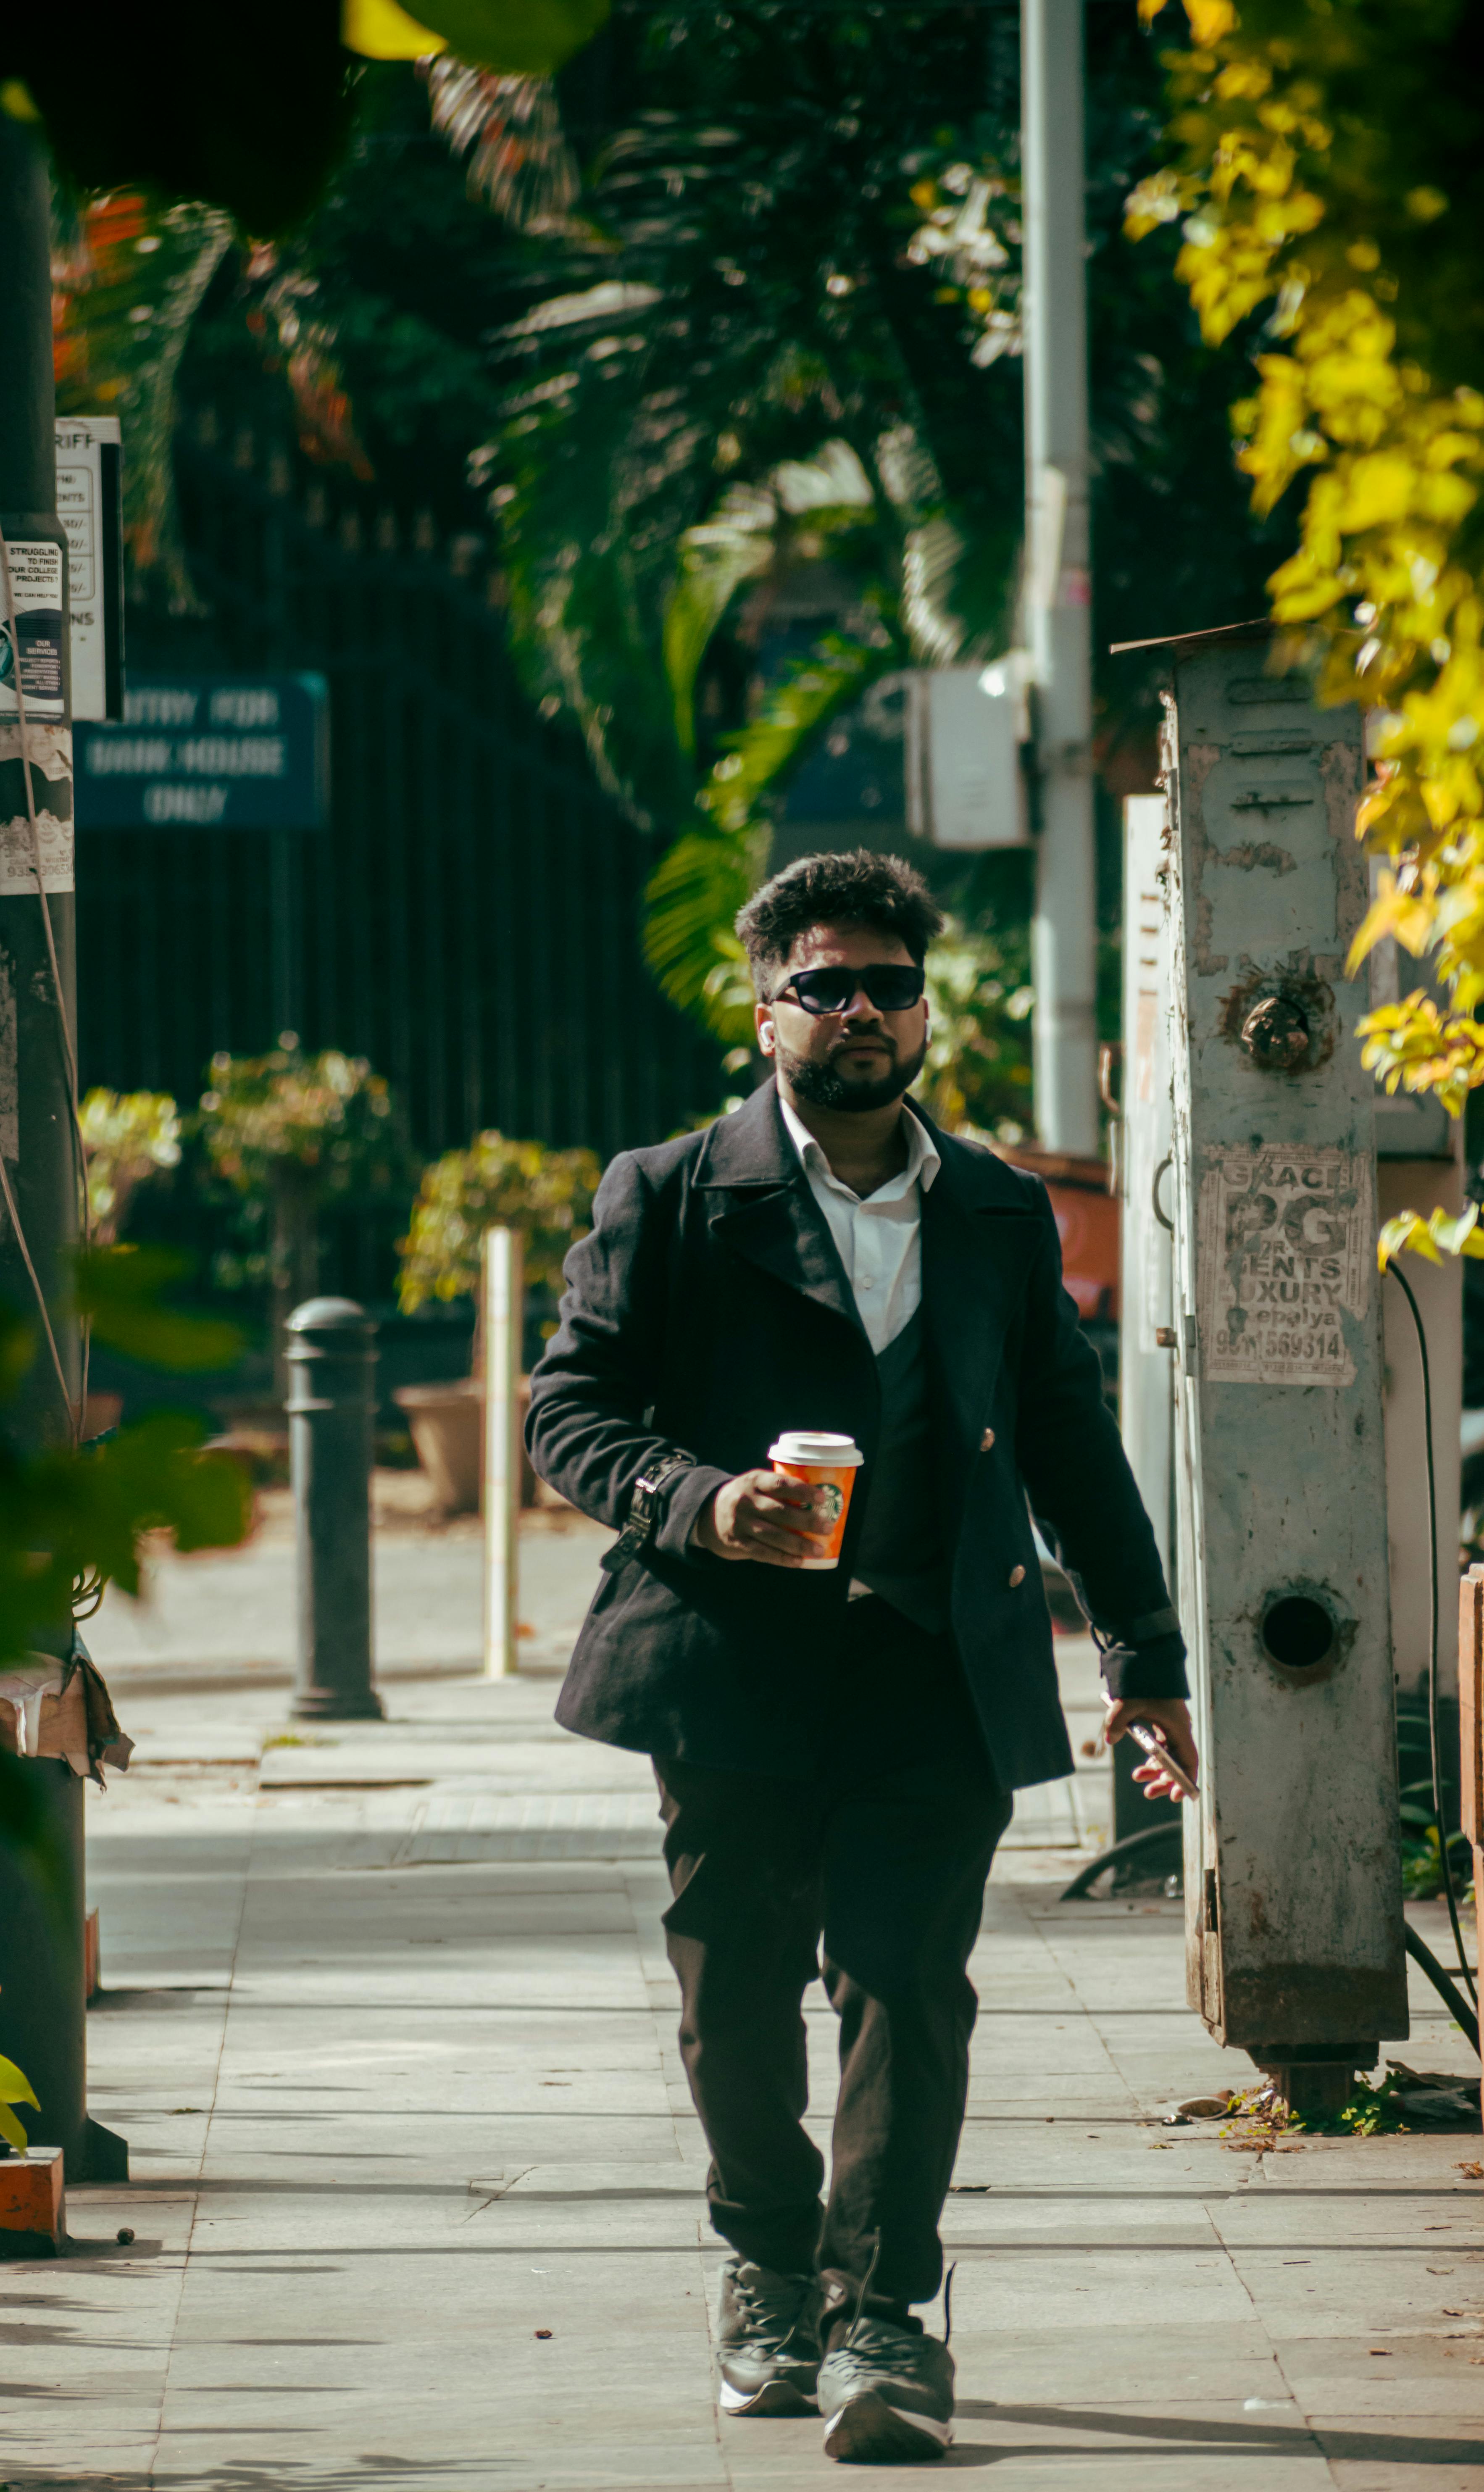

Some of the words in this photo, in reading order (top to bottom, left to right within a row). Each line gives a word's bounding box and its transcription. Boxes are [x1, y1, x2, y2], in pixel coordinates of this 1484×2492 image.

[55, 434, 94, 450] RIFF
[10, 547, 58, 556] STRUGGLING
[71, 612, 95, 626] NS
[26, 647, 58, 656] SERVICES
[1225, 1192, 1347, 1256] PG
[1224, 1255, 1342, 1279] ENTS
